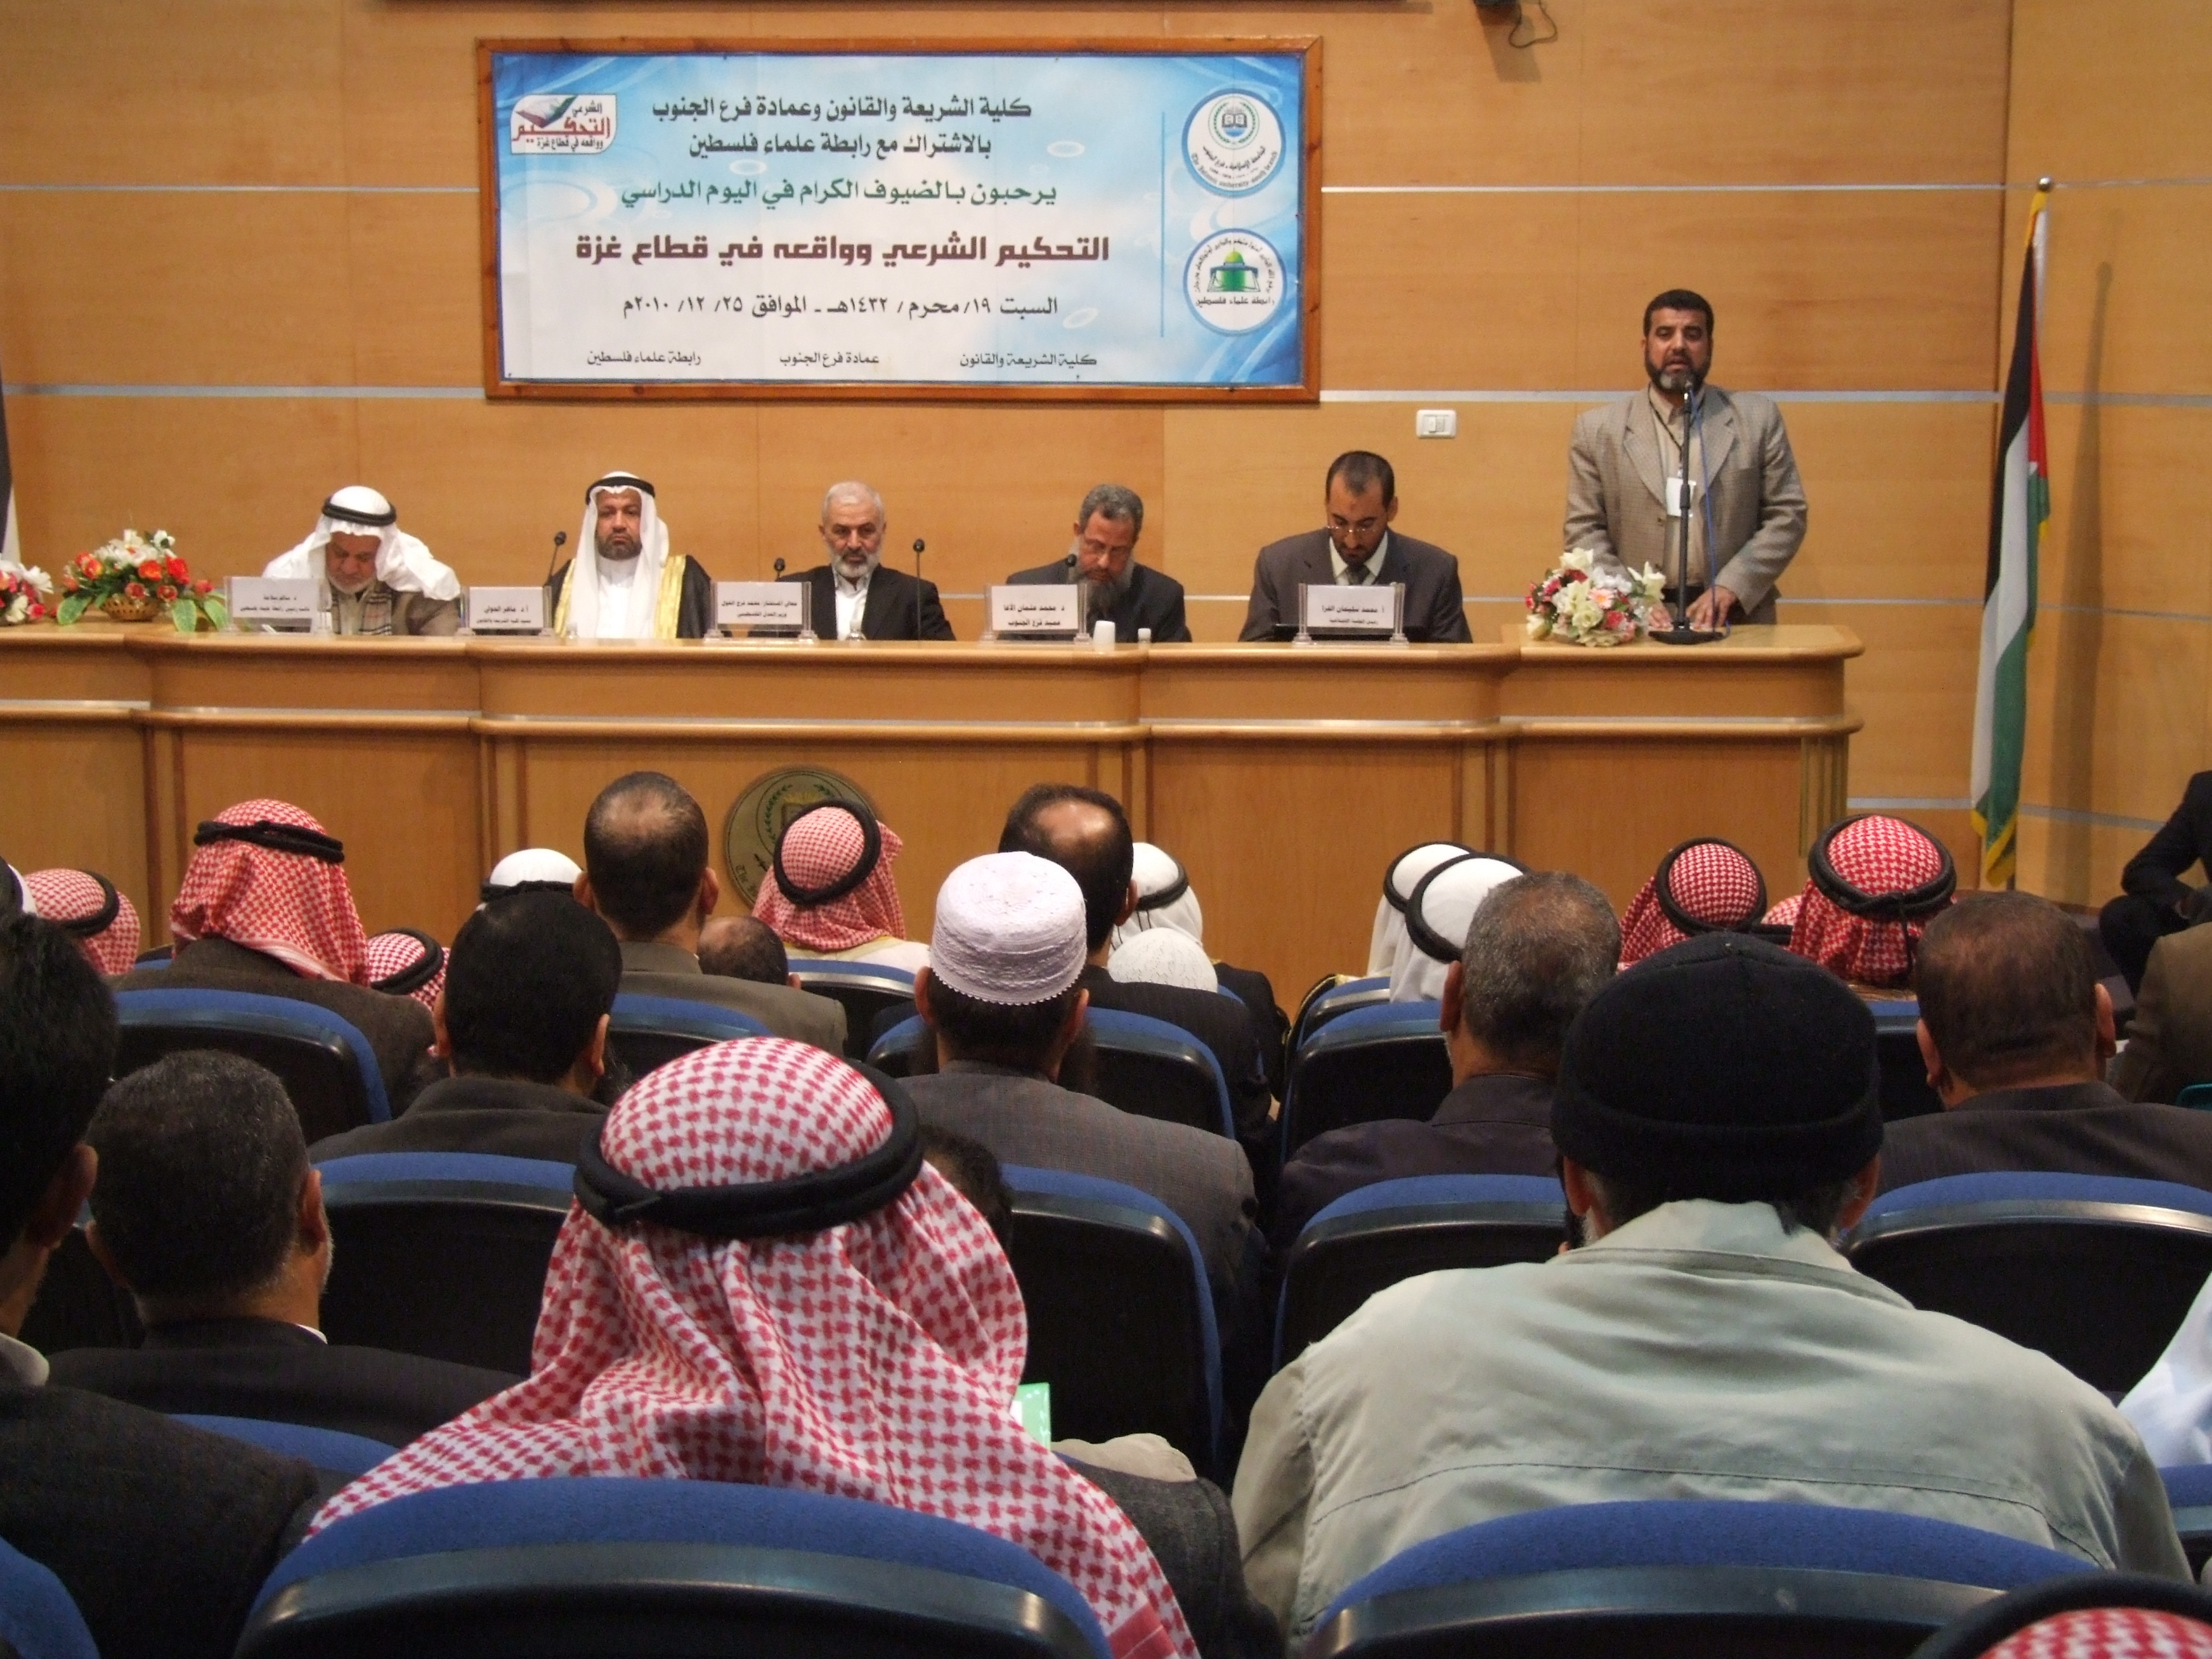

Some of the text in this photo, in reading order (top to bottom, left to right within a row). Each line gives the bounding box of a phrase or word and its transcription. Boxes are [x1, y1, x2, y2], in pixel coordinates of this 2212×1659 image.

[572, 100, 602, 117] الشرعي
[652, 94, 1032, 122] كلية الشريعة والقانون وعمادة فرع الجنوب
[512, 117, 611, 143] التحكيم
[537, 134, 603, 152] وواقعه في قطاع غزة
[689, 132, 992, 160] بالاشتراك مع رابطة علماء فلسطين
[621, 178, 1057, 211] يرحبون بالضيوف الكرام في اليوم الدراسي
[576, 230, 1109, 269] التحكيم الشرعي وواقعه في قطاع غزة
[751, 294, 807, 318] الموافق
[999, 296, 1058, 320] السبت
[1197, 296, 1226, 308] فلسطين
[1229, 296, 1249, 304] علماء
[587, 350, 701, 366] رابطة علماء فلسطين
[779, 351, 880, 368] عمادة فرع الجنوب
[960, 353, 1097, 369] كلية الشريعة والقانون
